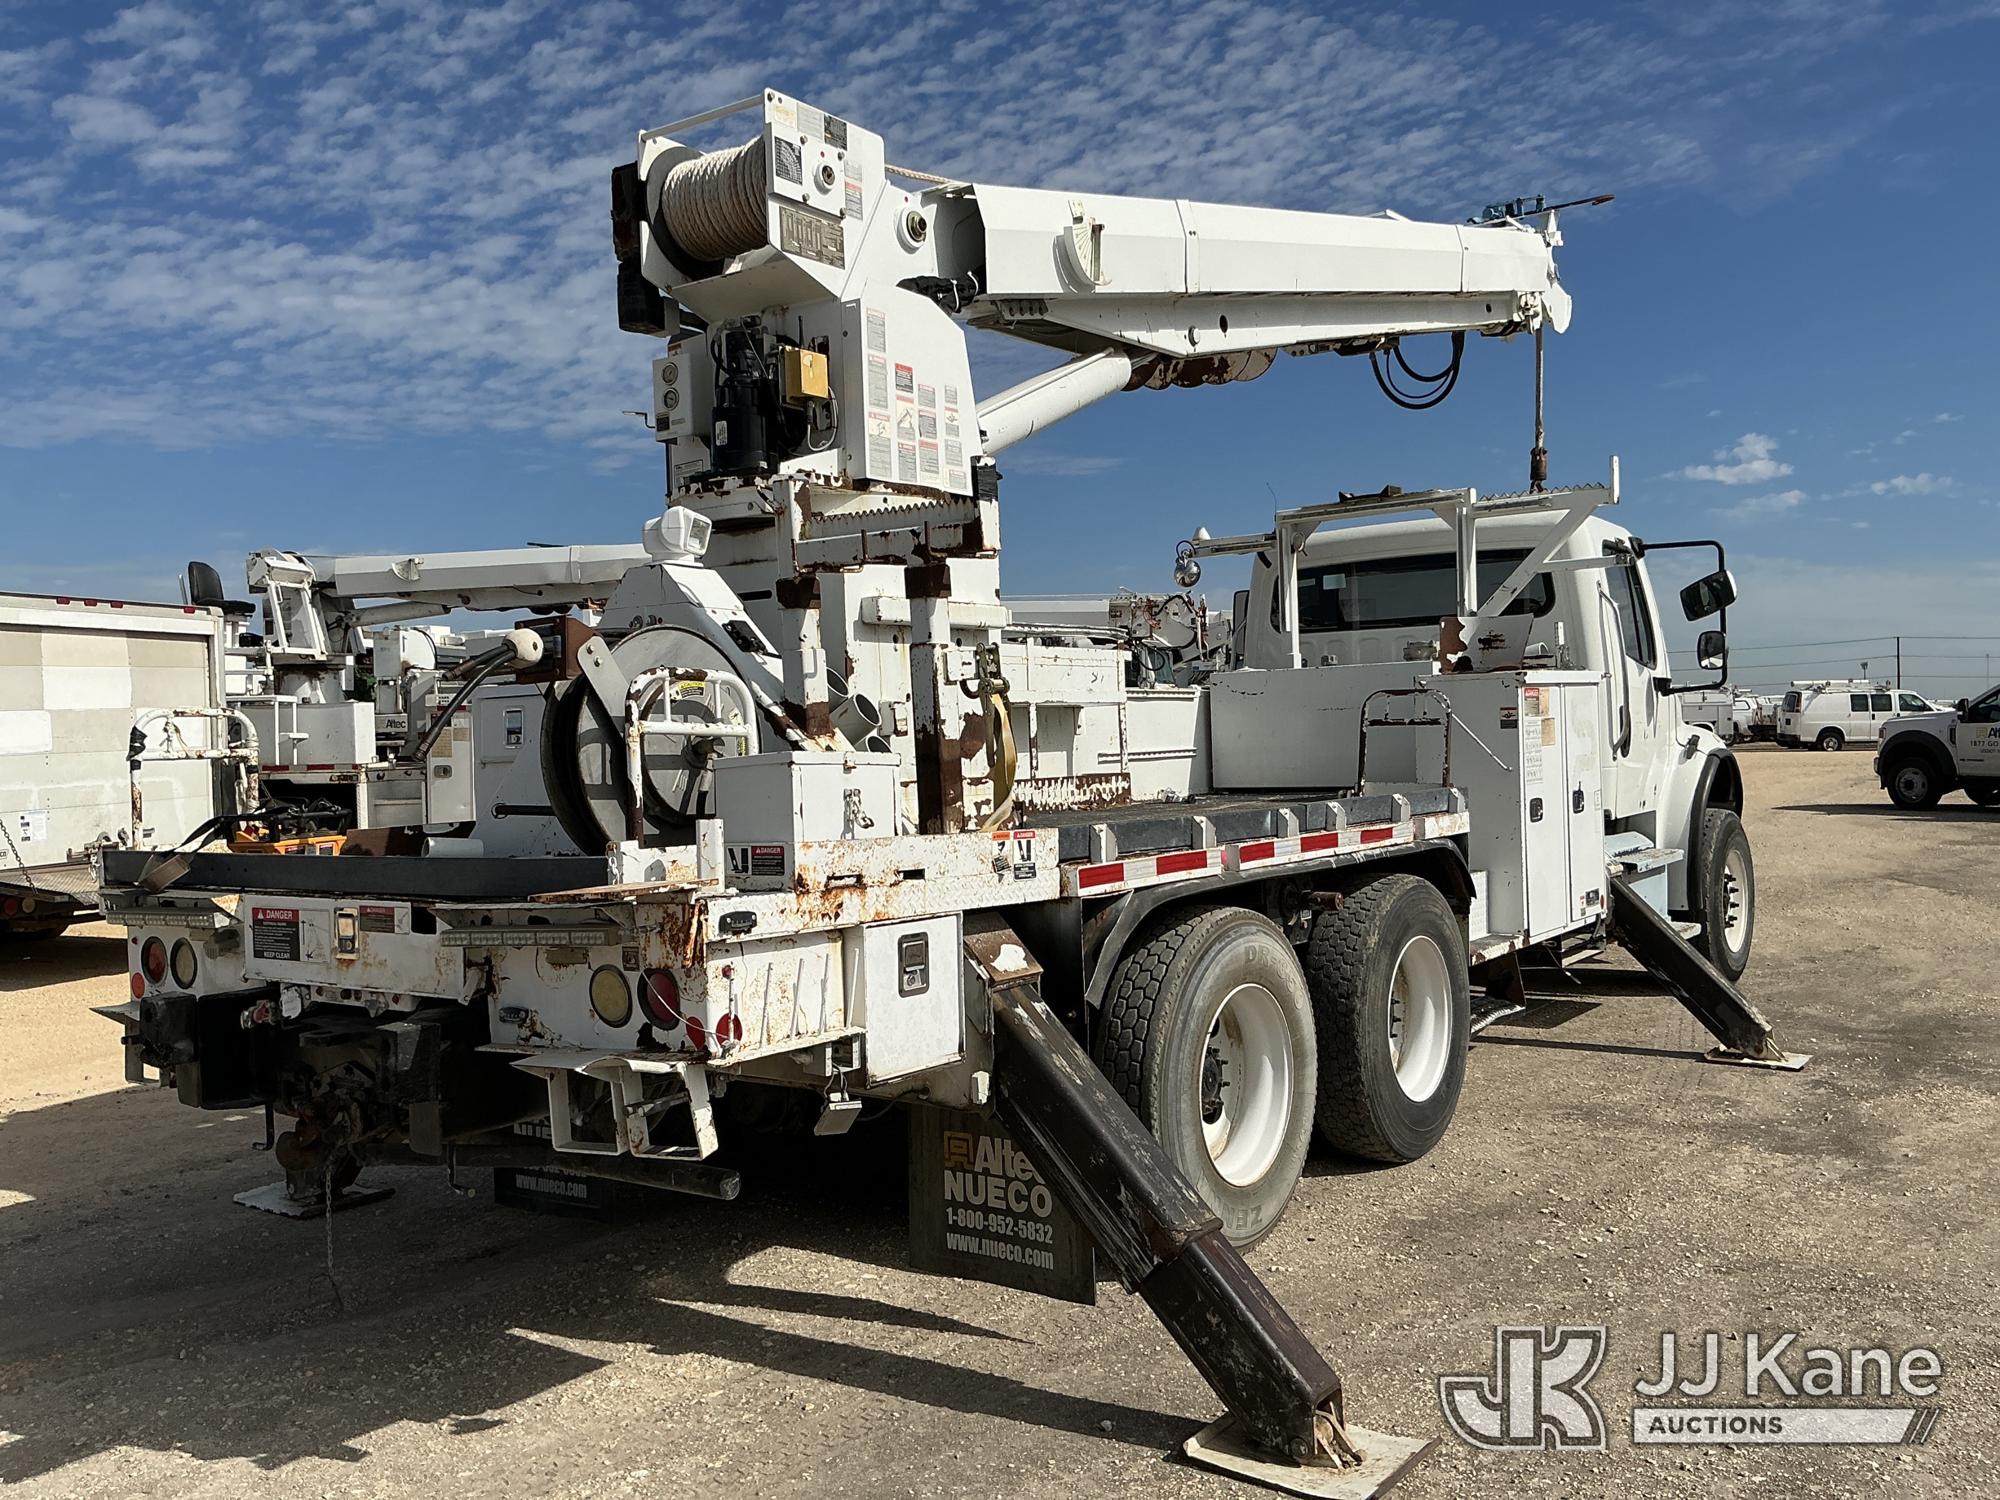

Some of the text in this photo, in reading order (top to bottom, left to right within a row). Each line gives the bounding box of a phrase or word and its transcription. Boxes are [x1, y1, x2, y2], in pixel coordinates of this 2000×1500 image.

[386, 719, 407, 729] Altec
[266, 910, 293, 920] DANGER
[974, 1135, 1045, 1185] Alte
[515, 1174, 588, 1199] www.nueco.com
[943, 1169, 1053, 1218] NUECO
[945, 1206, 1053, 1245] 1-800-952-5832
[946, 1232, 1054, 1271] www.nueco.com
